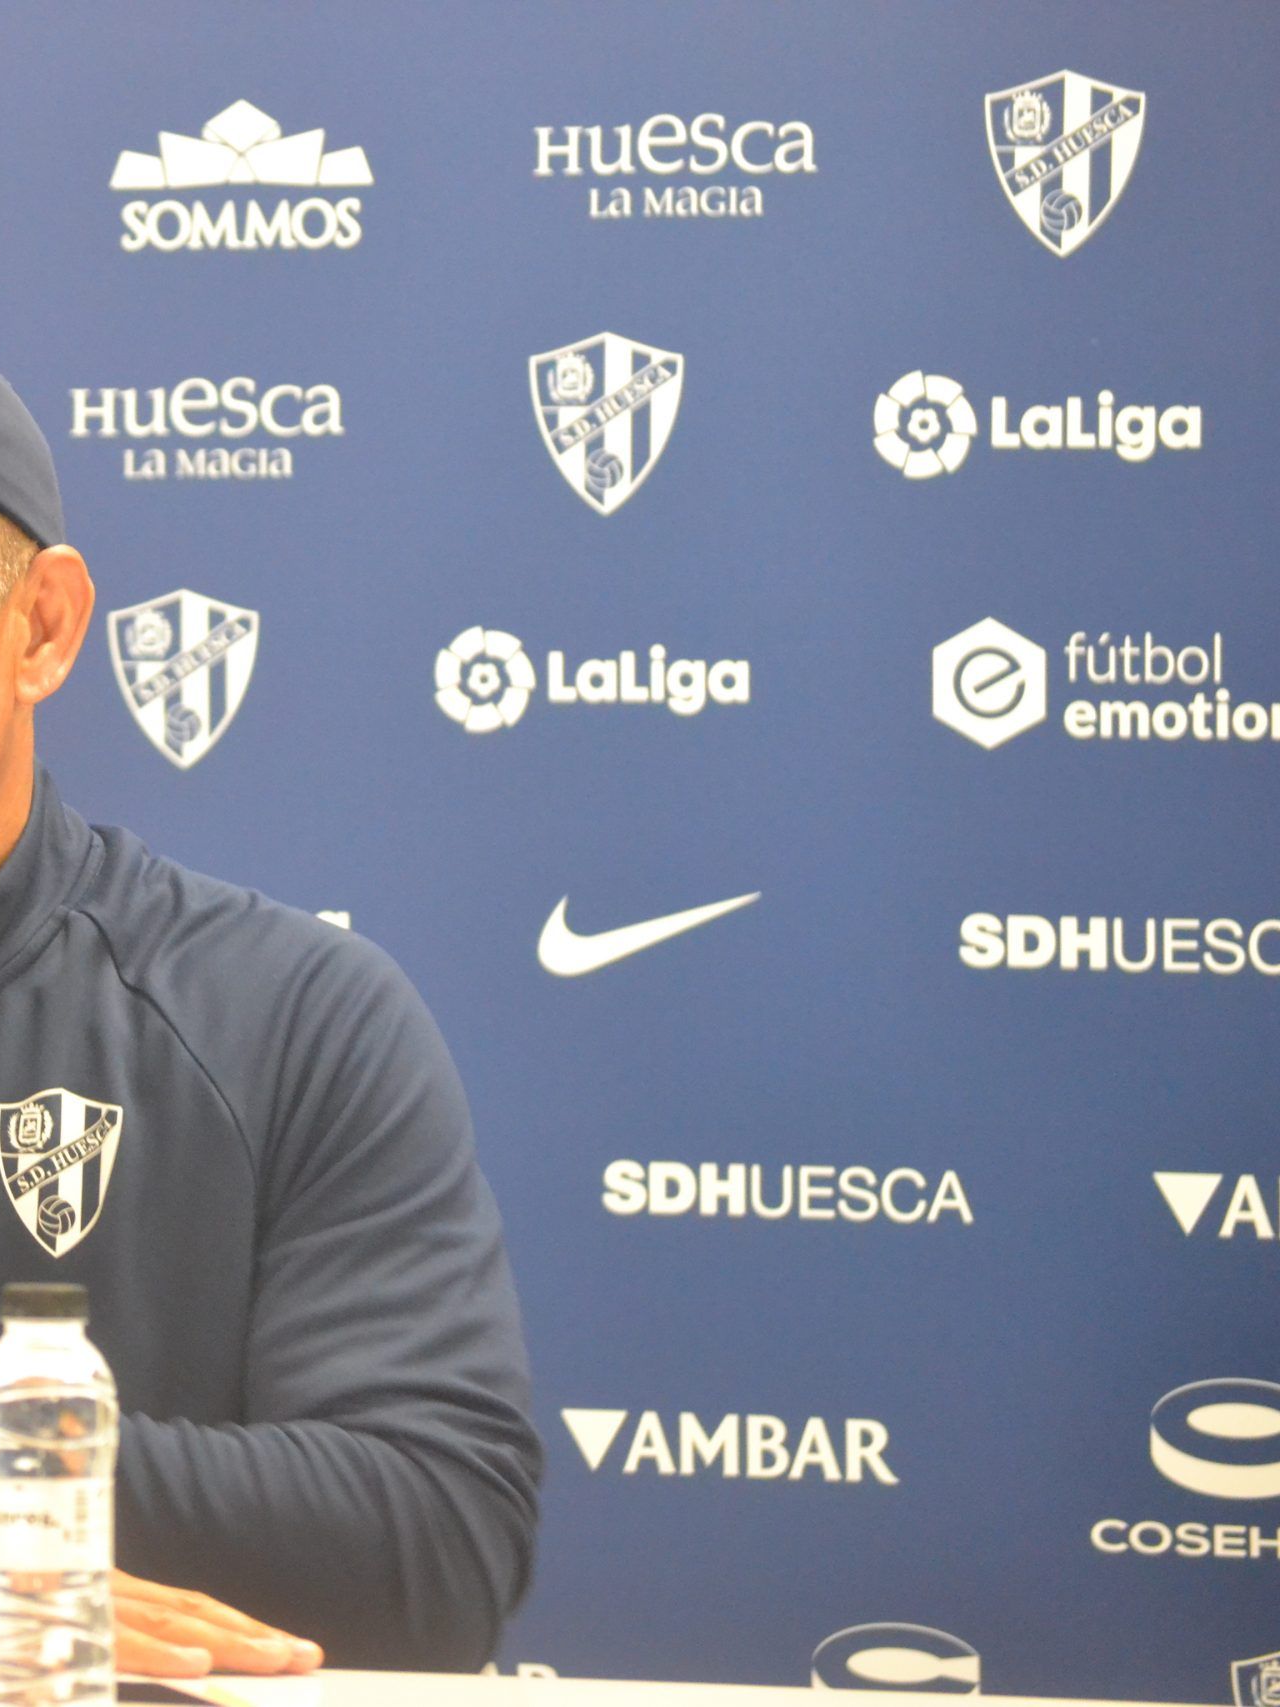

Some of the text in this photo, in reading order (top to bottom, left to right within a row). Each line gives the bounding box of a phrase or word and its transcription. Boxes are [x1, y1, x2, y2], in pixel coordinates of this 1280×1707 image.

[534, 113, 816, 176] Huesca
[1053, 103, 1134, 163] HUESCA
[121, 197, 361, 251] SOMMOS
[71, 377, 344, 437] Huesca
[991, 390, 1201, 462] LaLiga
[548, 644, 750, 715] LaLiga
[1065, 632, 1221, 684] fútbol
[1064, 688, 1280, 740] emotio
[16, 1119, 113, 1194] S.D. HUESCA
[602, 1160, 973, 1224] SDHUESCA
[623, 1410, 898, 1484] AMBAR
[1091, 1519, 1280, 1558] COSEH
